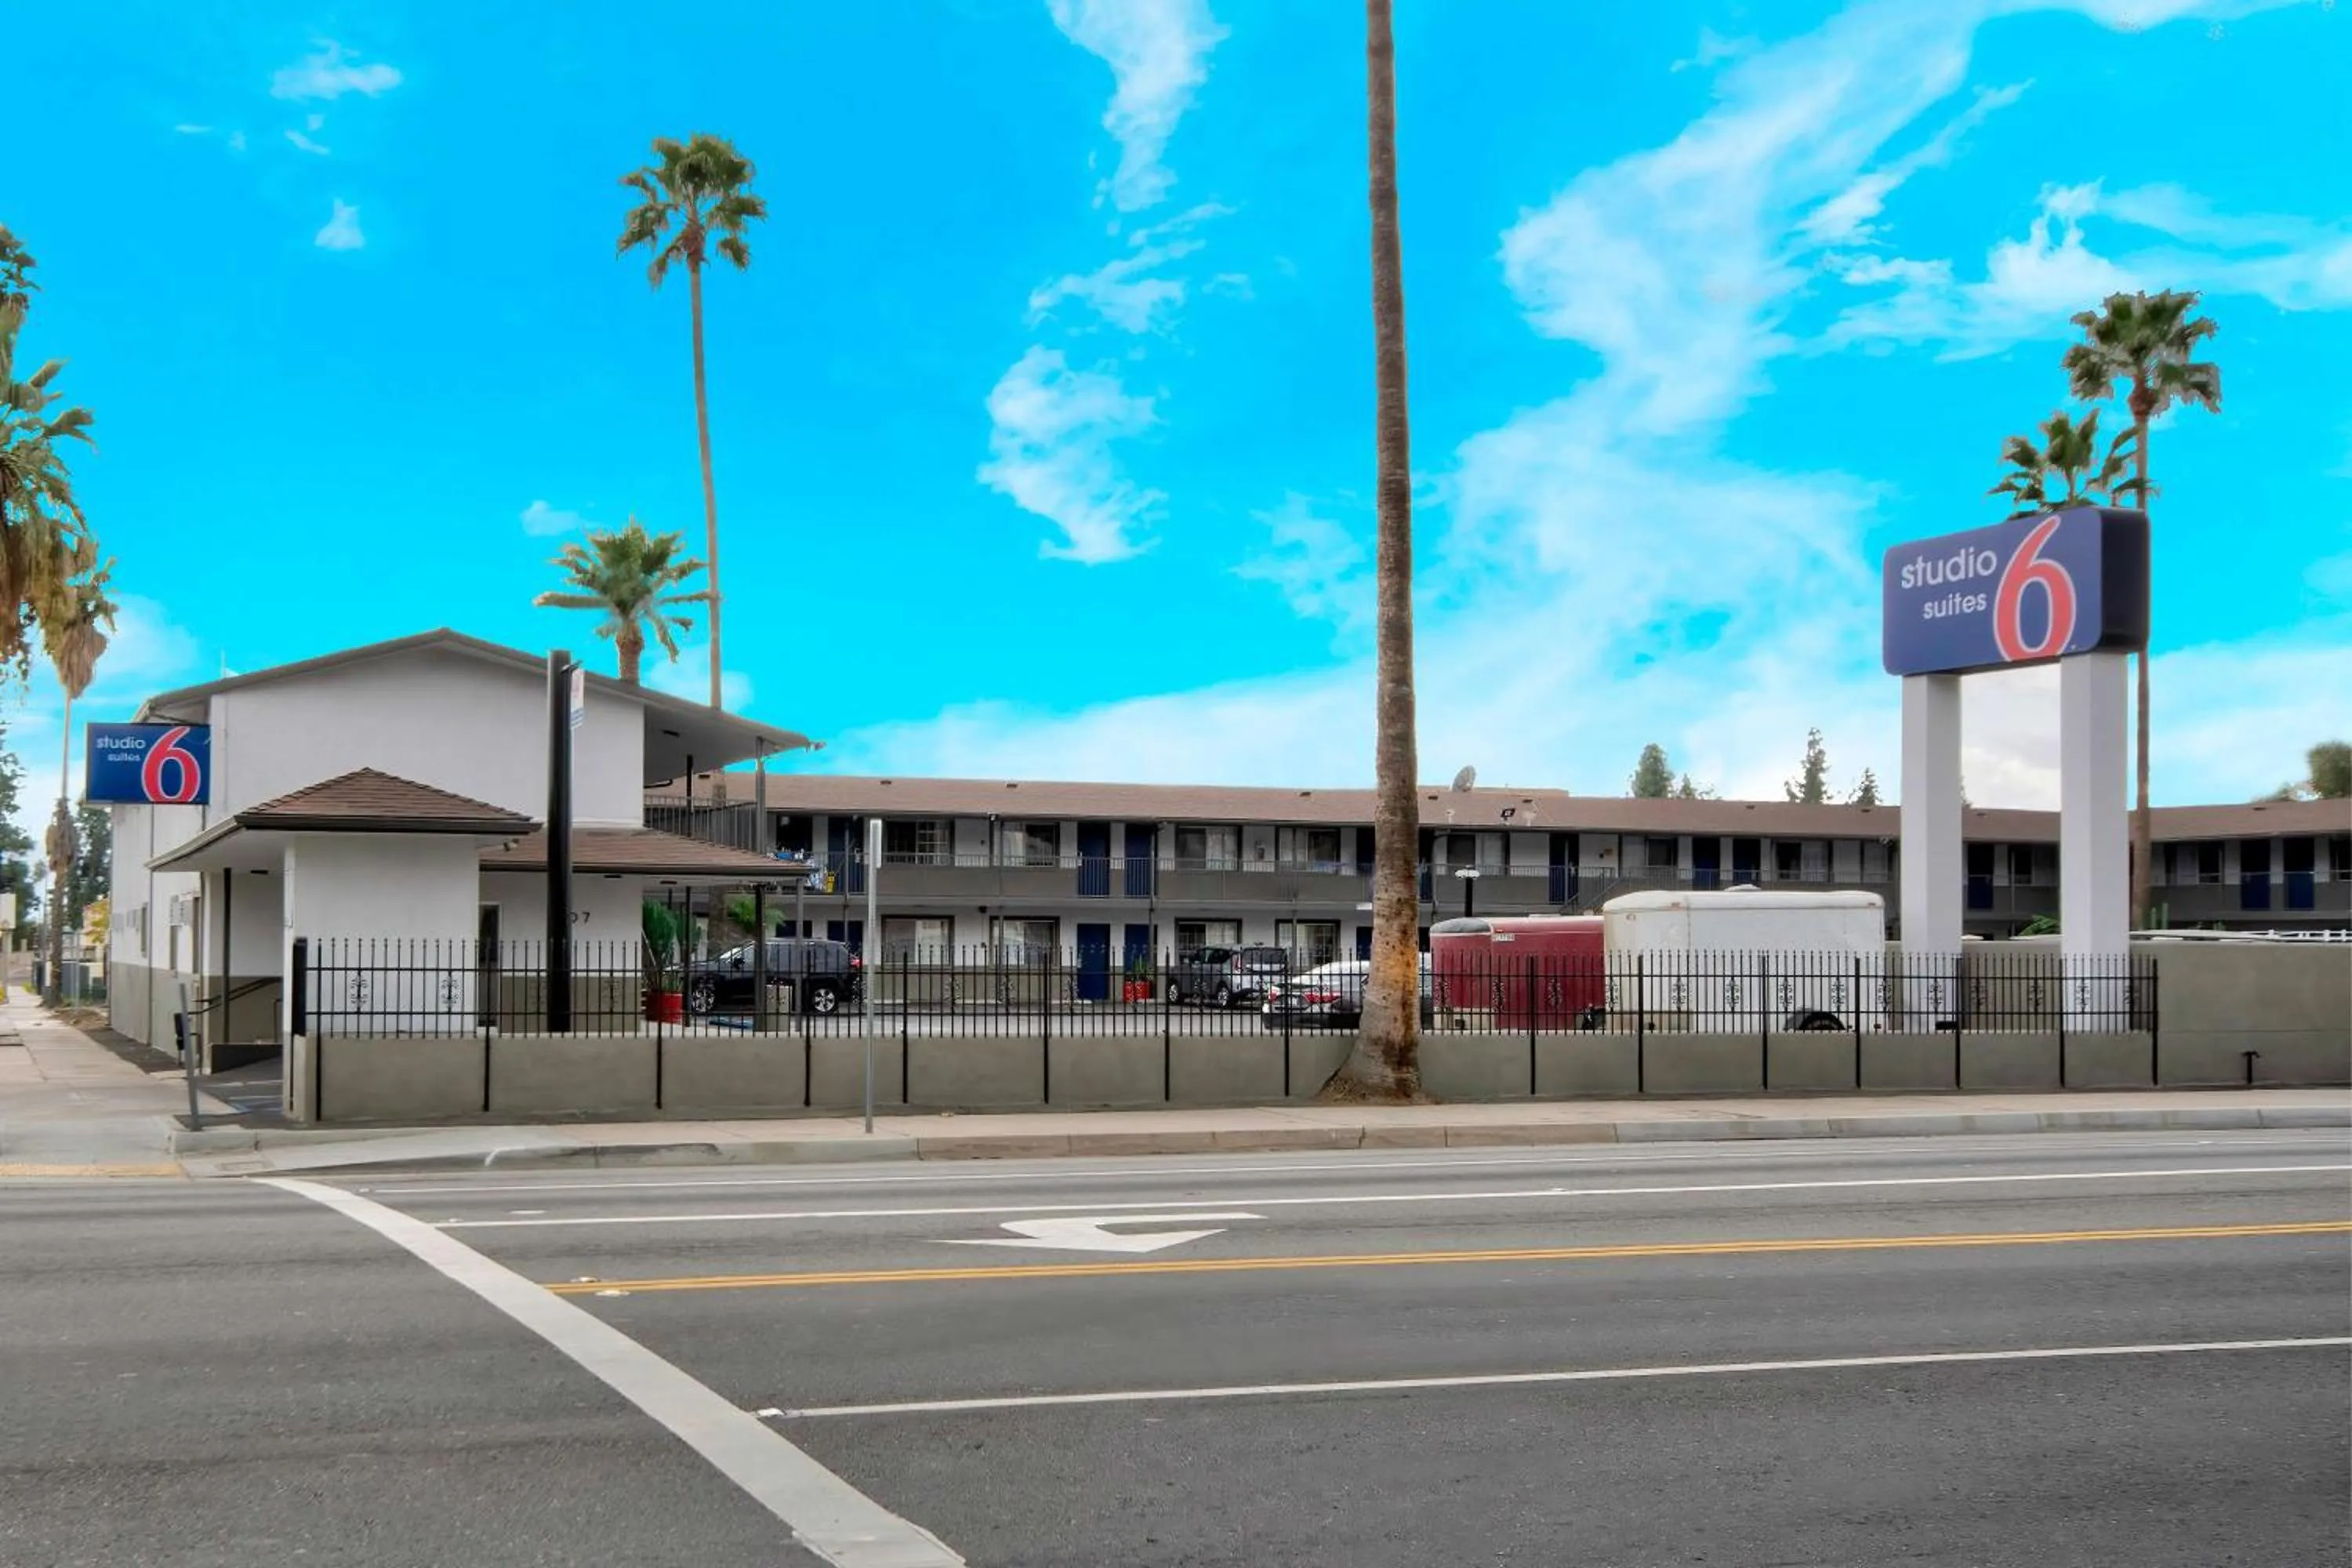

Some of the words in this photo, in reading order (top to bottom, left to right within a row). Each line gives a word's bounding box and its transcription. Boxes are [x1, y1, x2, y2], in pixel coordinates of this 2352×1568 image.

[1901, 546, 1997, 589] studio
[1993, 514, 2076, 662] 6
[1923, 593, 1987, 619] suites
[96, 735, 147, 749] studio
[107, 753, 141, 761] suites
[141, 726, 201, 802] 6
